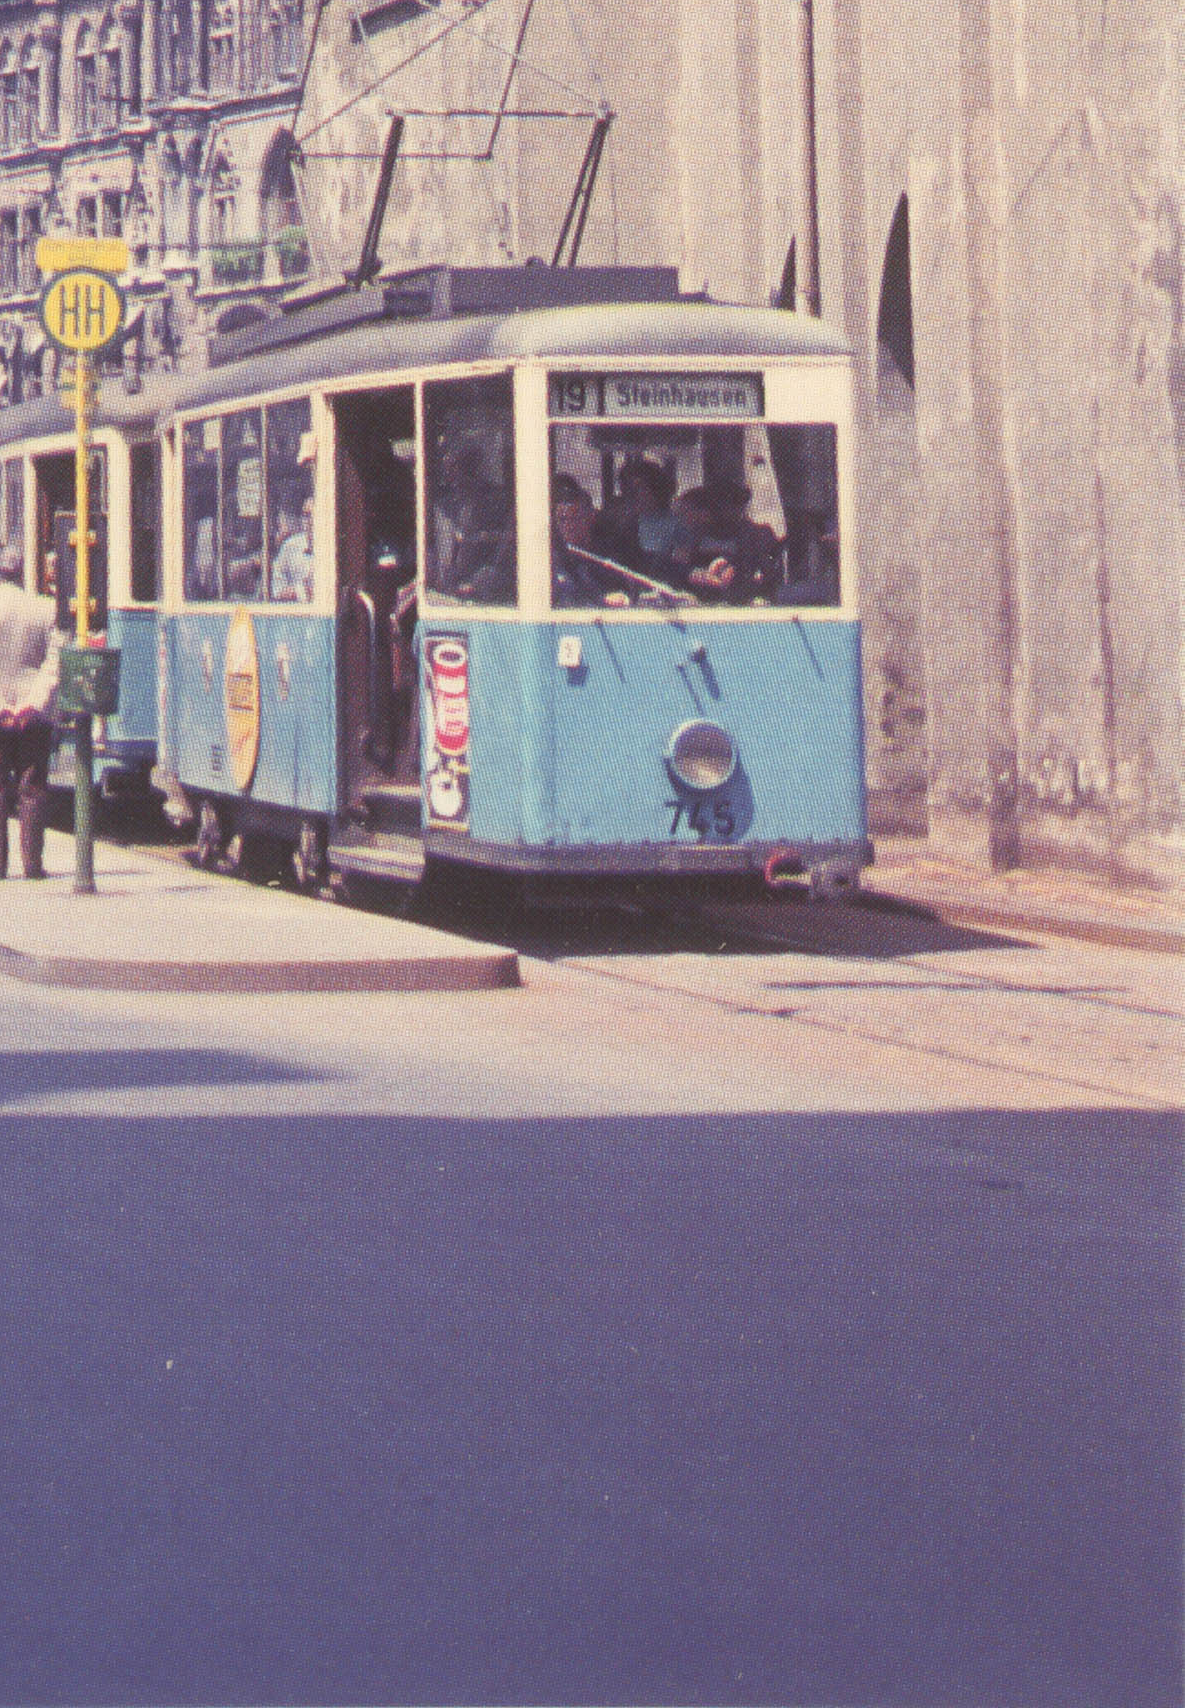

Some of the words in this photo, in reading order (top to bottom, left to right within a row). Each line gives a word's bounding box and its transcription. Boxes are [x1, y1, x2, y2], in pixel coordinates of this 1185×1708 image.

[59, 283, 106, 338] HH
[556, 378, 586, 412] 19
[617, 382, 747, 408] Steinhausen
